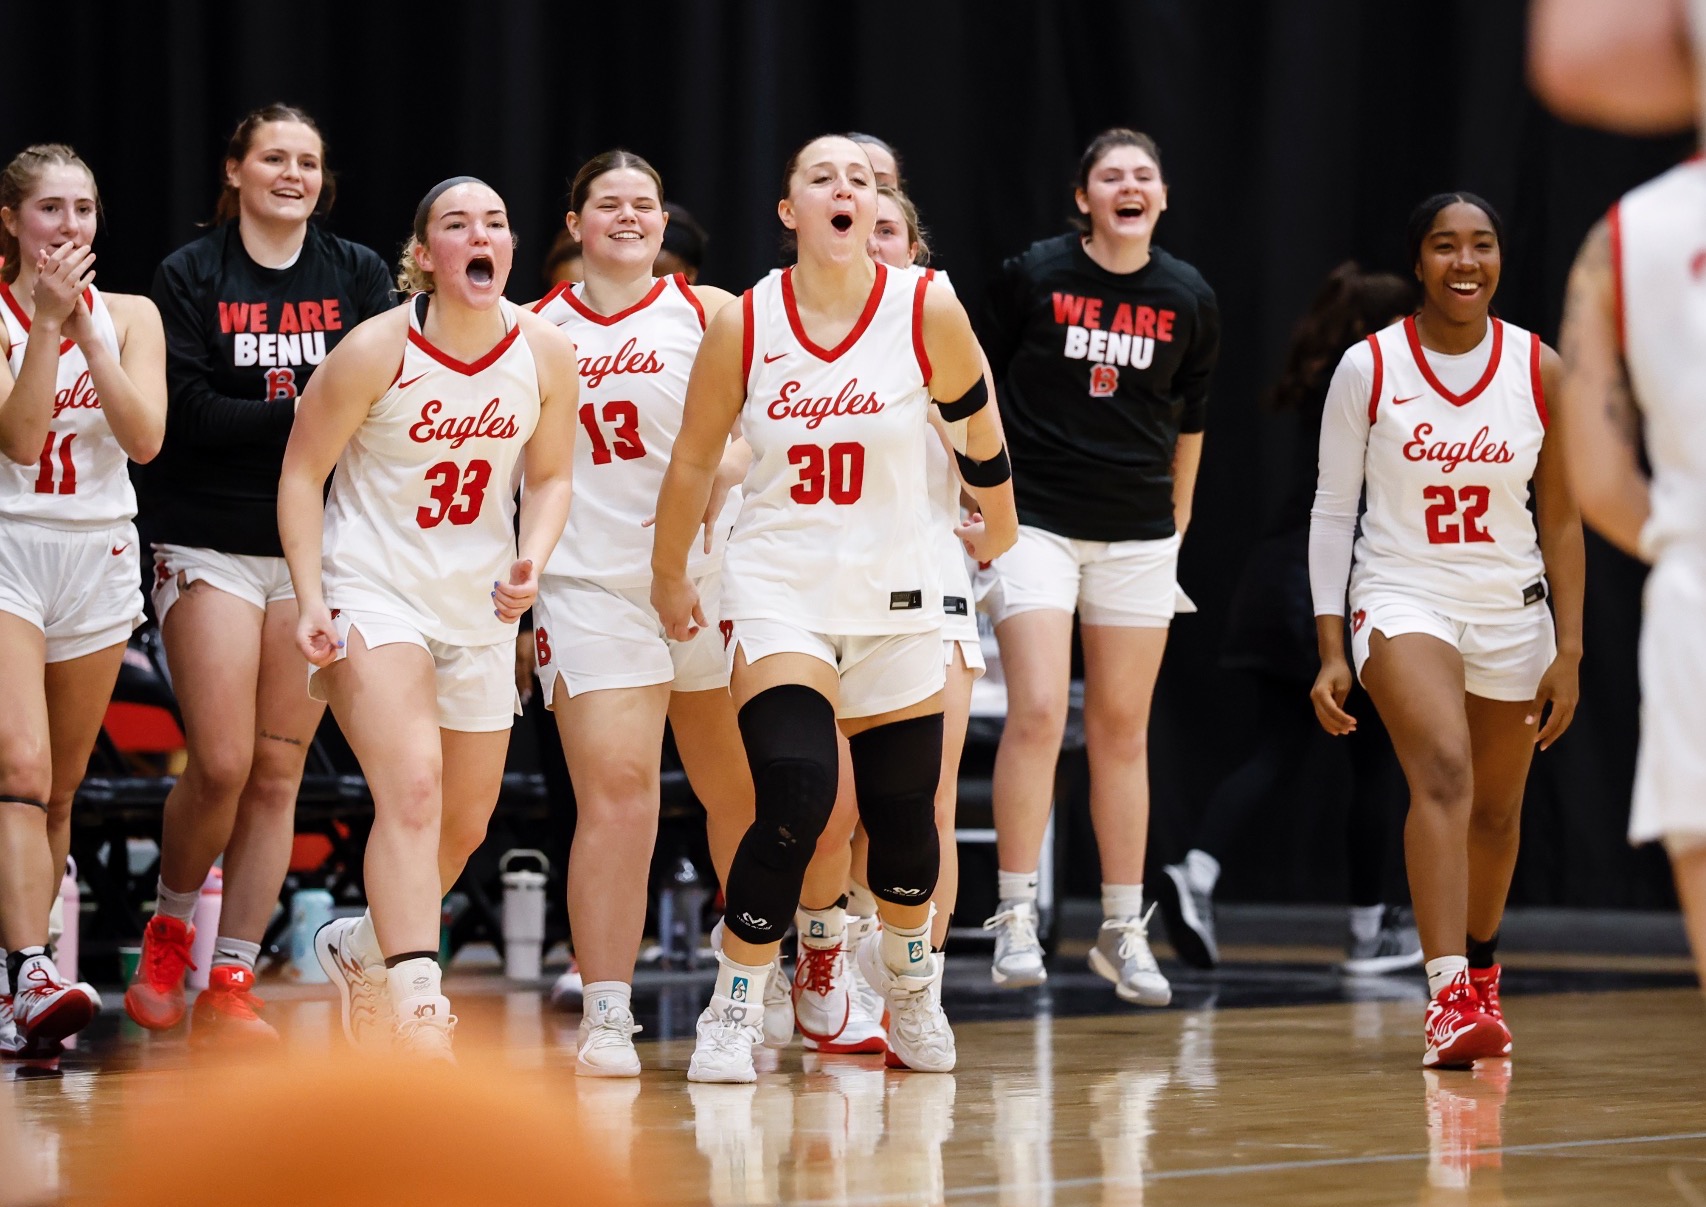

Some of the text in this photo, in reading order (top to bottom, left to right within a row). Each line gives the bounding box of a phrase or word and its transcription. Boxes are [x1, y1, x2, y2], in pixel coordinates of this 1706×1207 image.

[218, 298, 342, 333] WE ARE
[1052, 291, 1176, 342] WE ARE
[234, 331, 326, 366] BENU
[573, 337, 665, 388] agles
[1064, 325, 1155, 370] BENU
[264, 367, 298, 402] B
[767, 378, 885, 429] Eagles
[1089, 363, 1119, 398] B
[409, 397, 519, 449] Eagles
[579, 400, 647, 465] 13
[1403, 423, 1514, 473] Eagles
[35, 430, 78, 494] 11
[787, 441, 865, 505] 30
[416, 459, 492, 529] 33
[1423, 485, 1496, 544] 22
